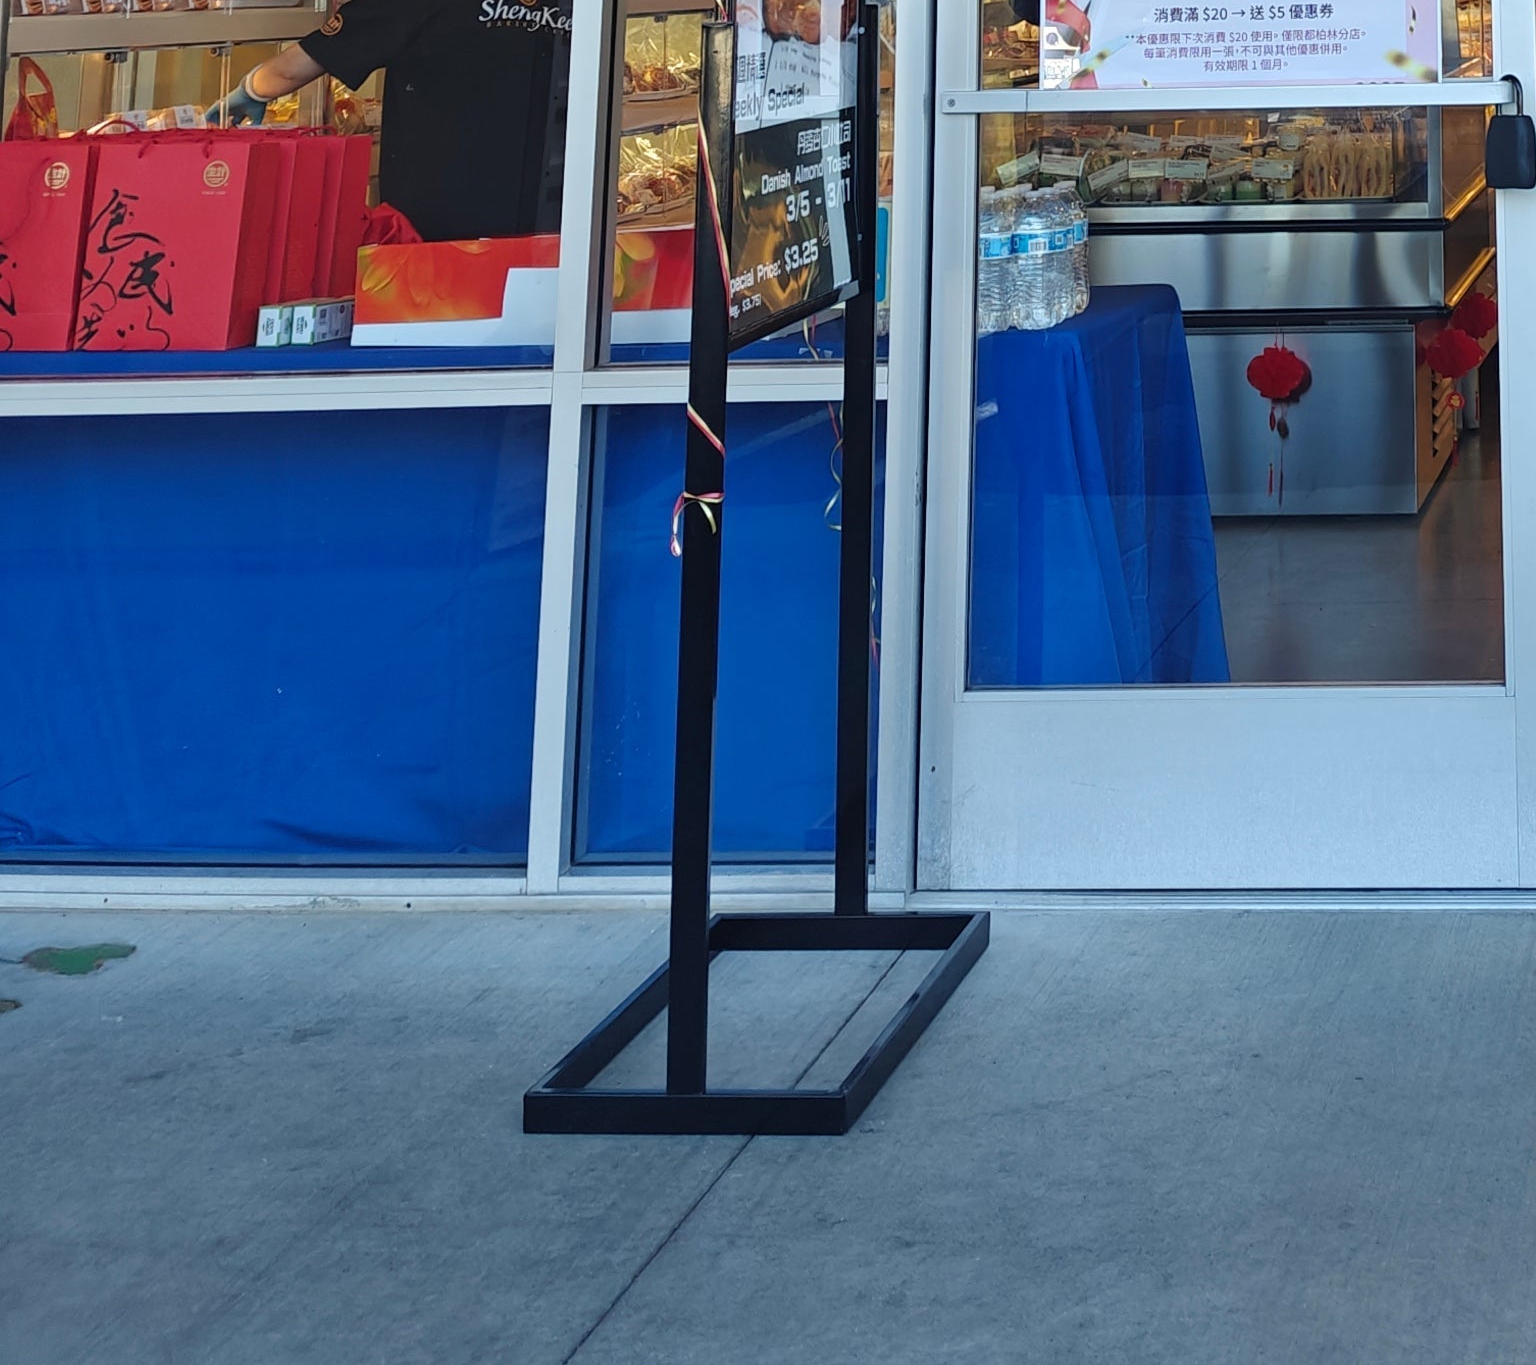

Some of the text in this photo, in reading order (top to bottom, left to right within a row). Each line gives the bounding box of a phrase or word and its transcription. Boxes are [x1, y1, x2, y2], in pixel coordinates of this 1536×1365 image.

[1153, 2, 1335, 24] 消費滿 $20 送 $5 優惠券
[1228, 31, 1249, 43] $20
[1203, 58, 1249, 73] 有效期限
[735, 81, 806, 122] eekly Special
[761, 151, 851, 195] Danish Almond Toast
[785, 189, 811, 223] 3/5
[826, 177, 851, 209] 3/11
[730, 236, 819, 299] pecial Price: $3.25
